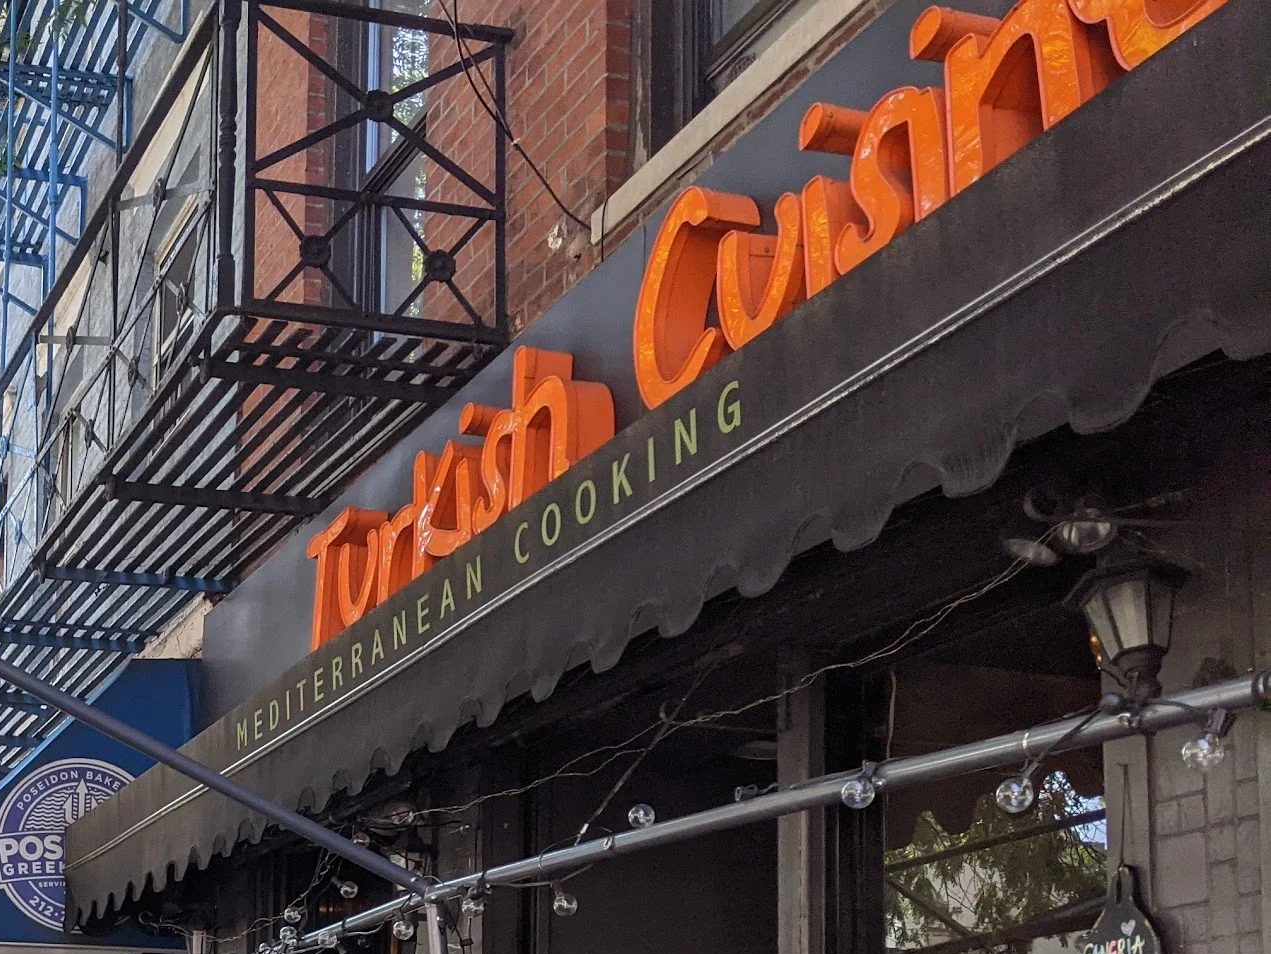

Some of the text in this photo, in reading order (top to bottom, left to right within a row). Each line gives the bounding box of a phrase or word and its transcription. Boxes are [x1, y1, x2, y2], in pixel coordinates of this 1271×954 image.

[236, 379, 743, 751] MEDITERRANEAN COOKING
[306, 345, 612, 652] Turkish
[16, 770, 122, 811] POSEIDON BAKE
